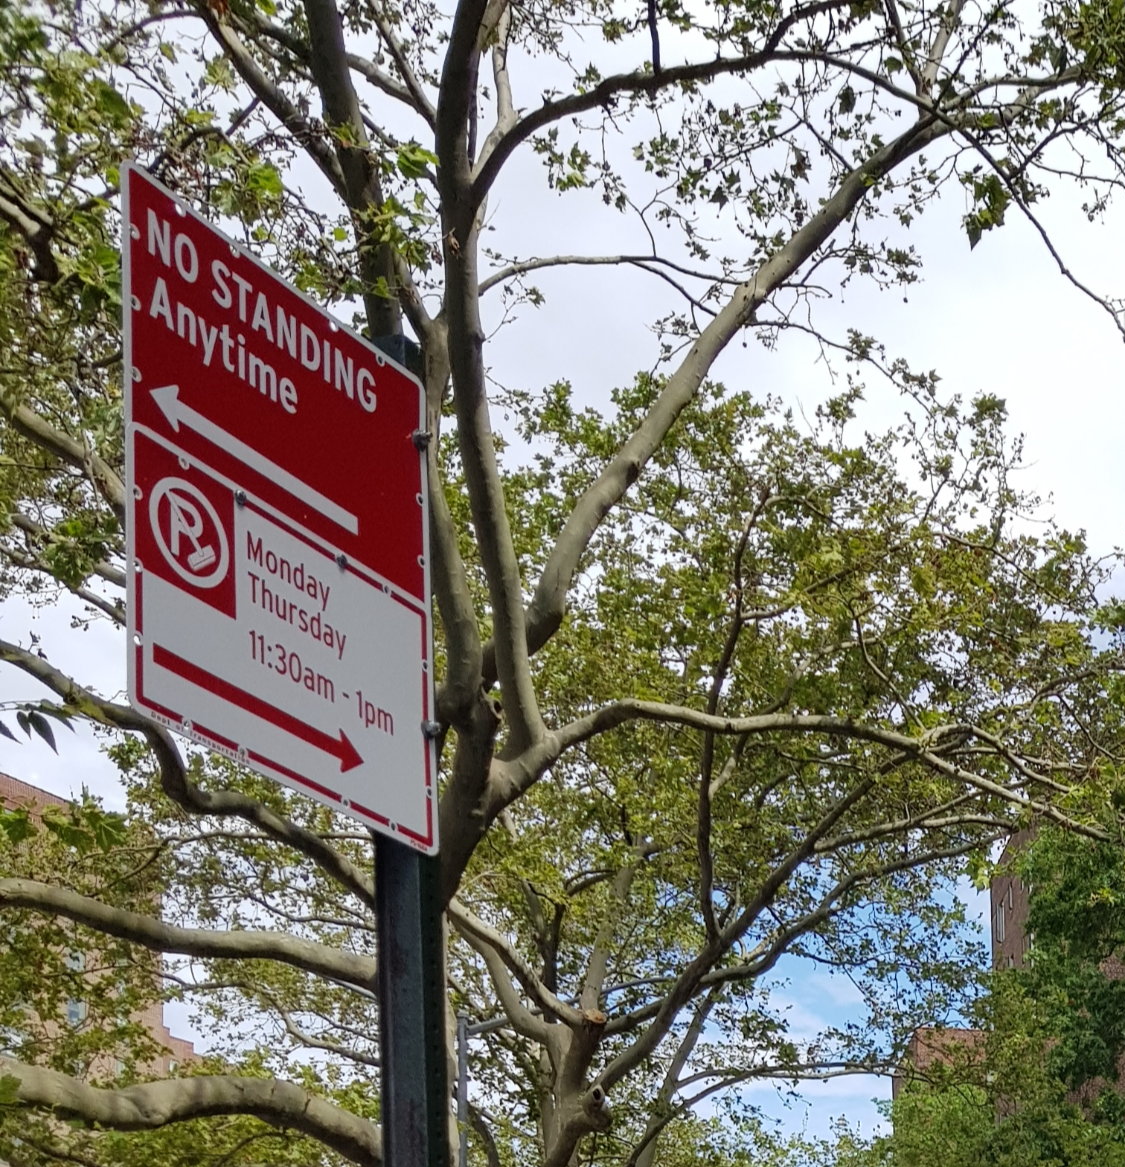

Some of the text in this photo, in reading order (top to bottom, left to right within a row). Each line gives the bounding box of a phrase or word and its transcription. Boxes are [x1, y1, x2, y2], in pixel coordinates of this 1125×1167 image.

[147, 207, 377, 413] NO STANDING
[149, 276, 298, 414] Anytime
[246, 530, 330, 611] Monday
[247, 570, 347, 660] Thursday
[249, 629, 335, 703] 11:30am
[355, 689, 394, 736] 1pm
